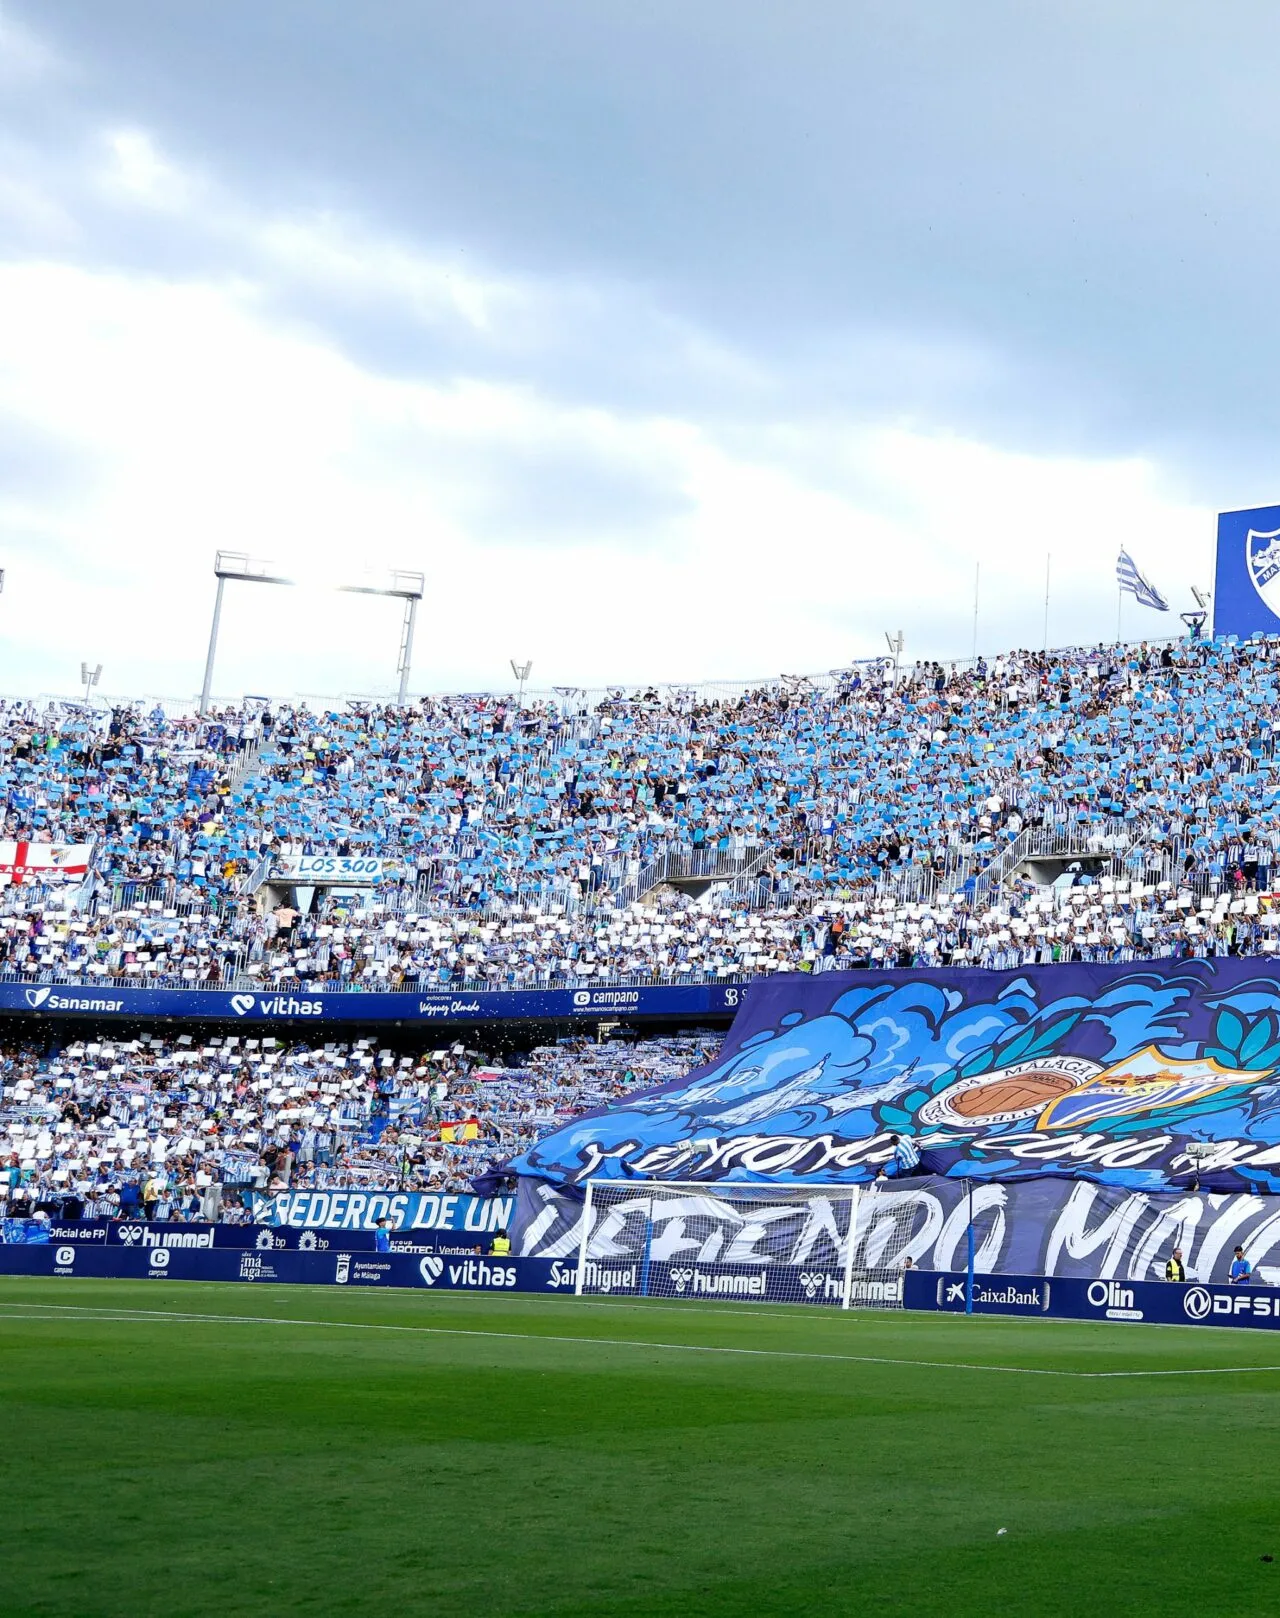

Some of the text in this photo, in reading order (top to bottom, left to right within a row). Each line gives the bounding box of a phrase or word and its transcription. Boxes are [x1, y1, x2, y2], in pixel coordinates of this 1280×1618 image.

[0, 866, 34, 875] AGA
[300, 858, 378, 873] LOS 300
[48, 995, 124, 1011] Sanamar
[593, 991, 639, 1005] campano
[260, 997, 323, 1015] vithas
[254, 1191, 512, 1232] REDEROS DE UN
[48, 1228, 105, 1239] Oficial de FP
[143, 1228, 214, 1248] hummel
[275, 1236, 286, 1248] bp
[317, 1238, 329, 1250] bp
[354, 1262, 391, 1270] Ayuntamiento
[449, 1259, 517, 1287] vithas
[361, 1271, 381, 1280] Málaga
[693, 1269, 766, 1295] hummel
[971, 1284, 1040, 1306] CaixaBank
[1087, 1281, 1134, 1308] Olin
